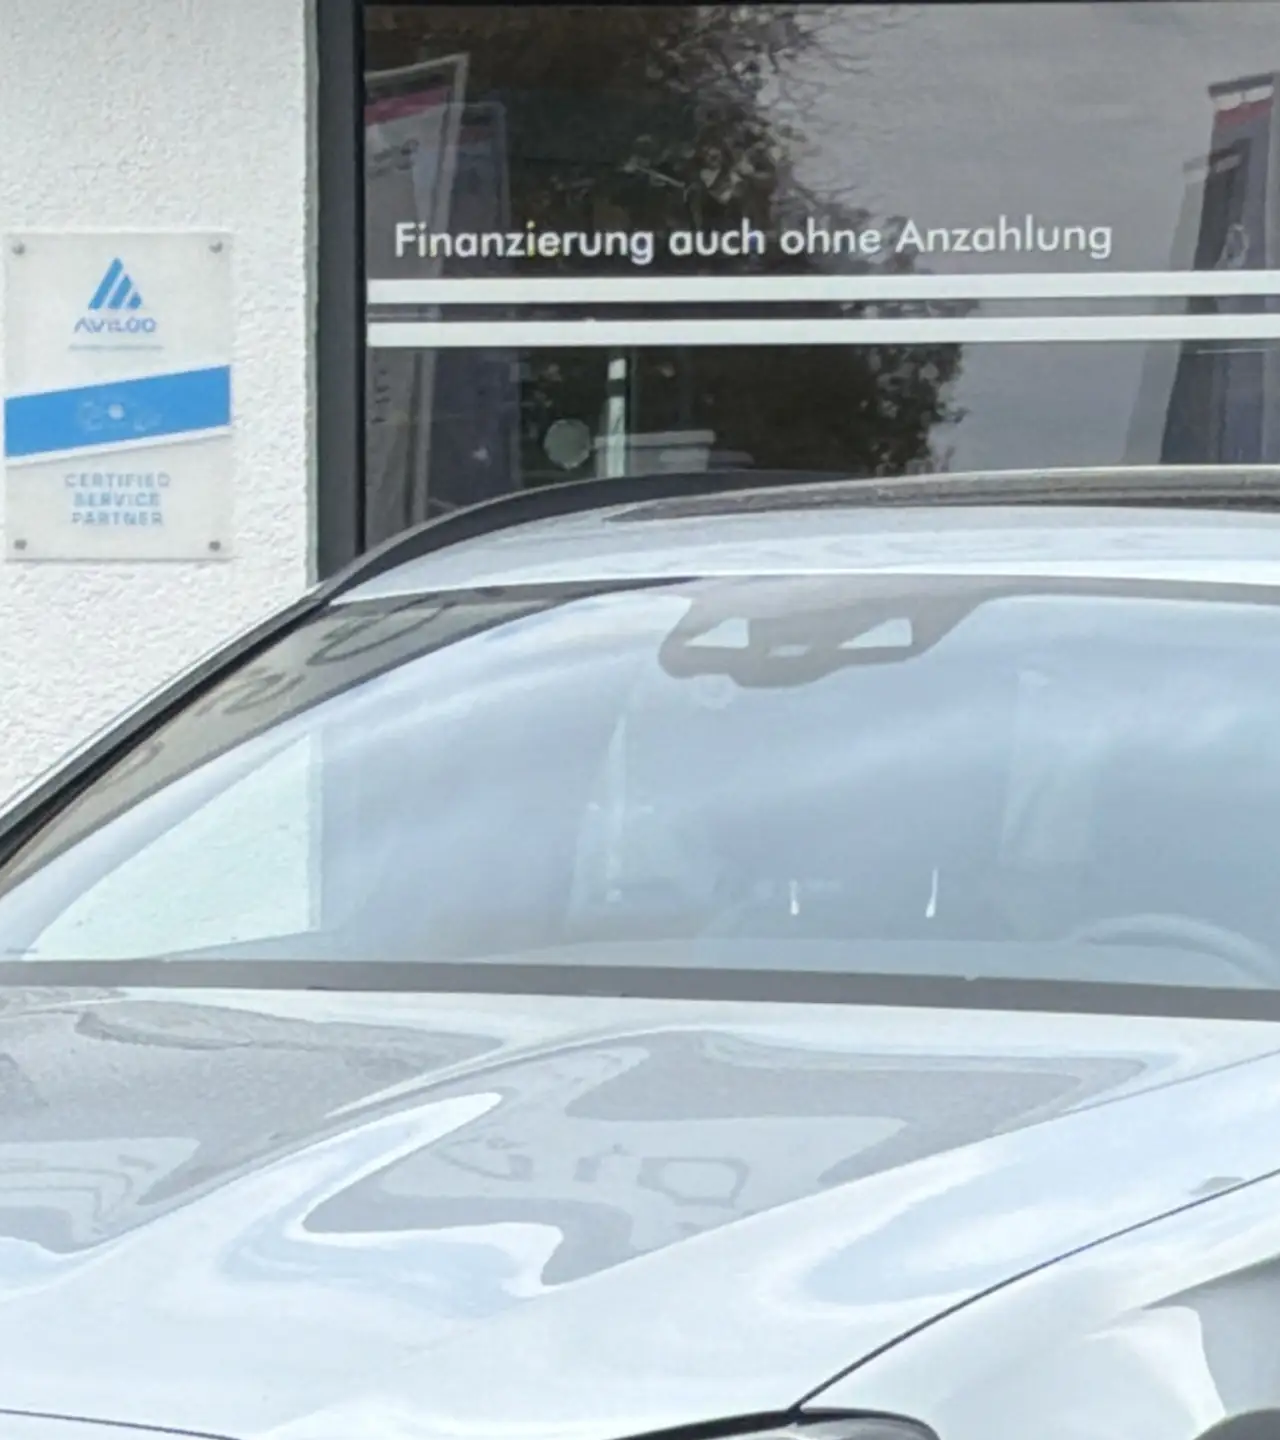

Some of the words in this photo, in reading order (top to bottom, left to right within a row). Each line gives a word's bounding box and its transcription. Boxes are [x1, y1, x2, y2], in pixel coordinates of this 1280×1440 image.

[395, 220, 653, 264] Finanzierung
[669, 217, 765, 256] auch
[780, 217, 881, 255] ohne
[895, 214, 1113, 260] Anzahlung
[64, 472, 171, 489] CERTIFIED
[73, 491, 161, 508] SERVICE
[71, 511, 163, 526] PARTNER
